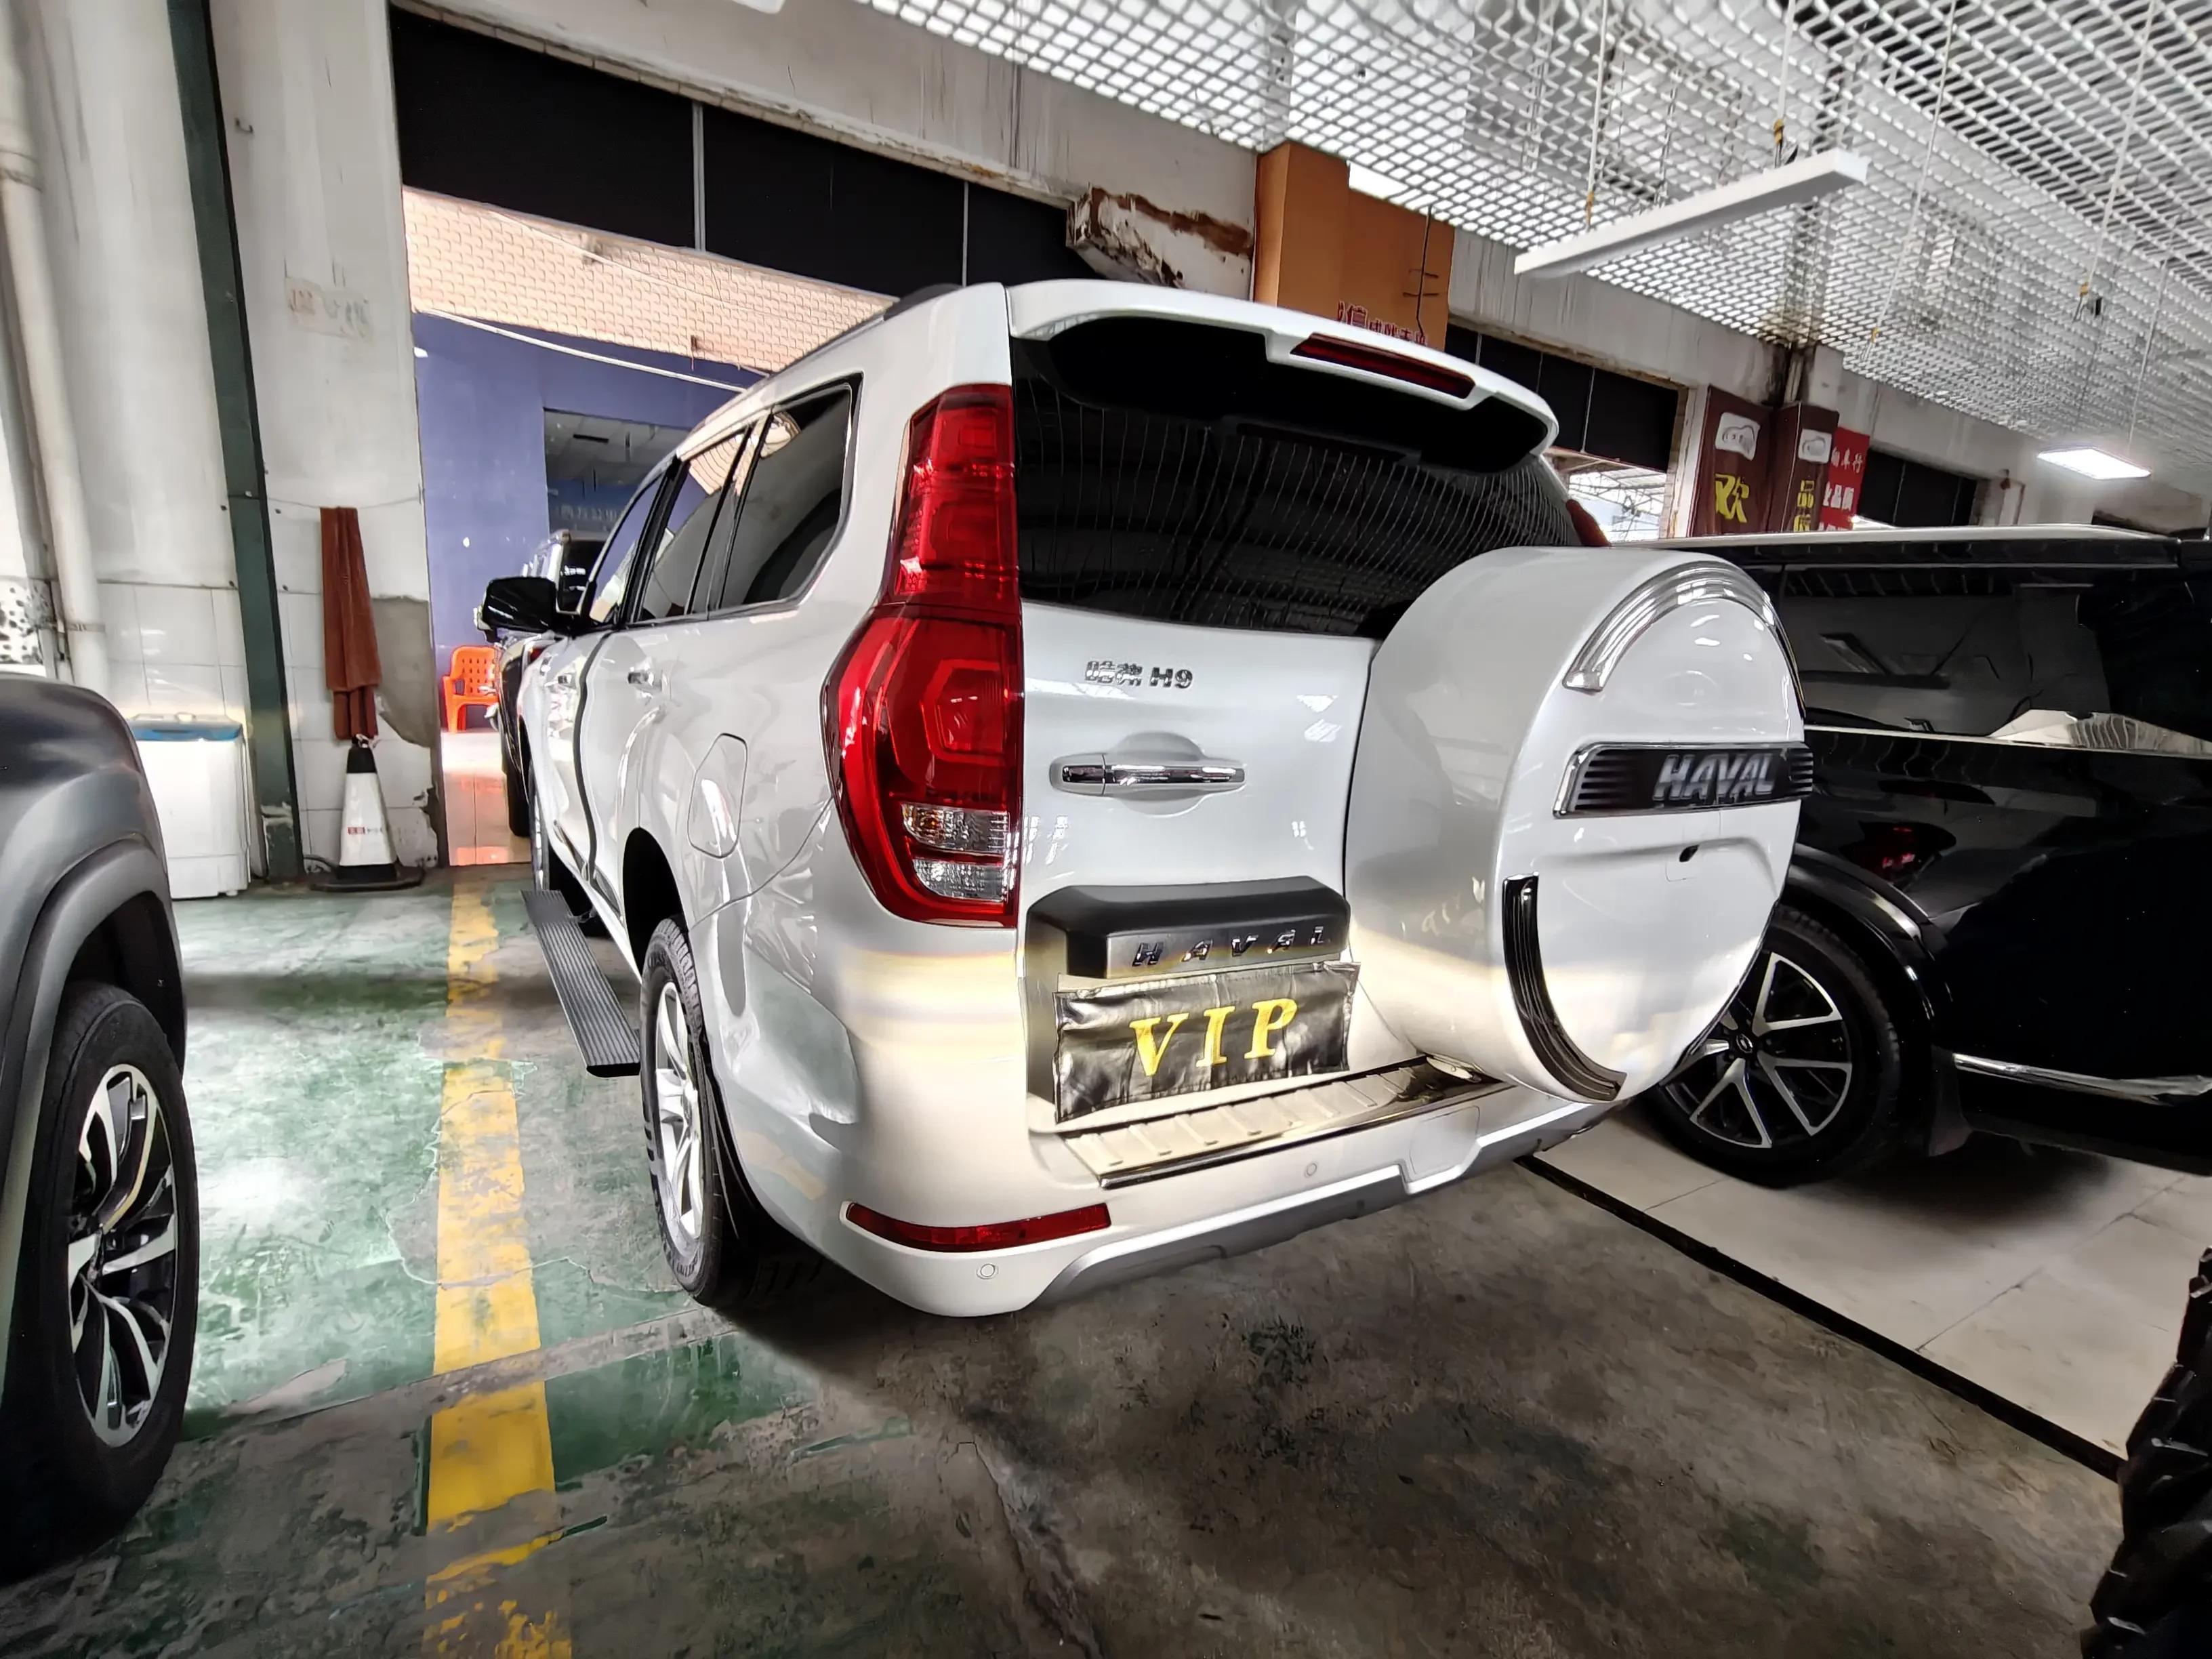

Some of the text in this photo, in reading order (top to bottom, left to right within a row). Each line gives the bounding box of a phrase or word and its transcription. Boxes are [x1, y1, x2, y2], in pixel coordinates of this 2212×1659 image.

[1149, 667, 1193, 689] H9
[1652, 753, 1776, 802] HAVAL
[1131, 925, 1331, 967] HAVAL
[1129, 998, 1298, 1077] VIP
